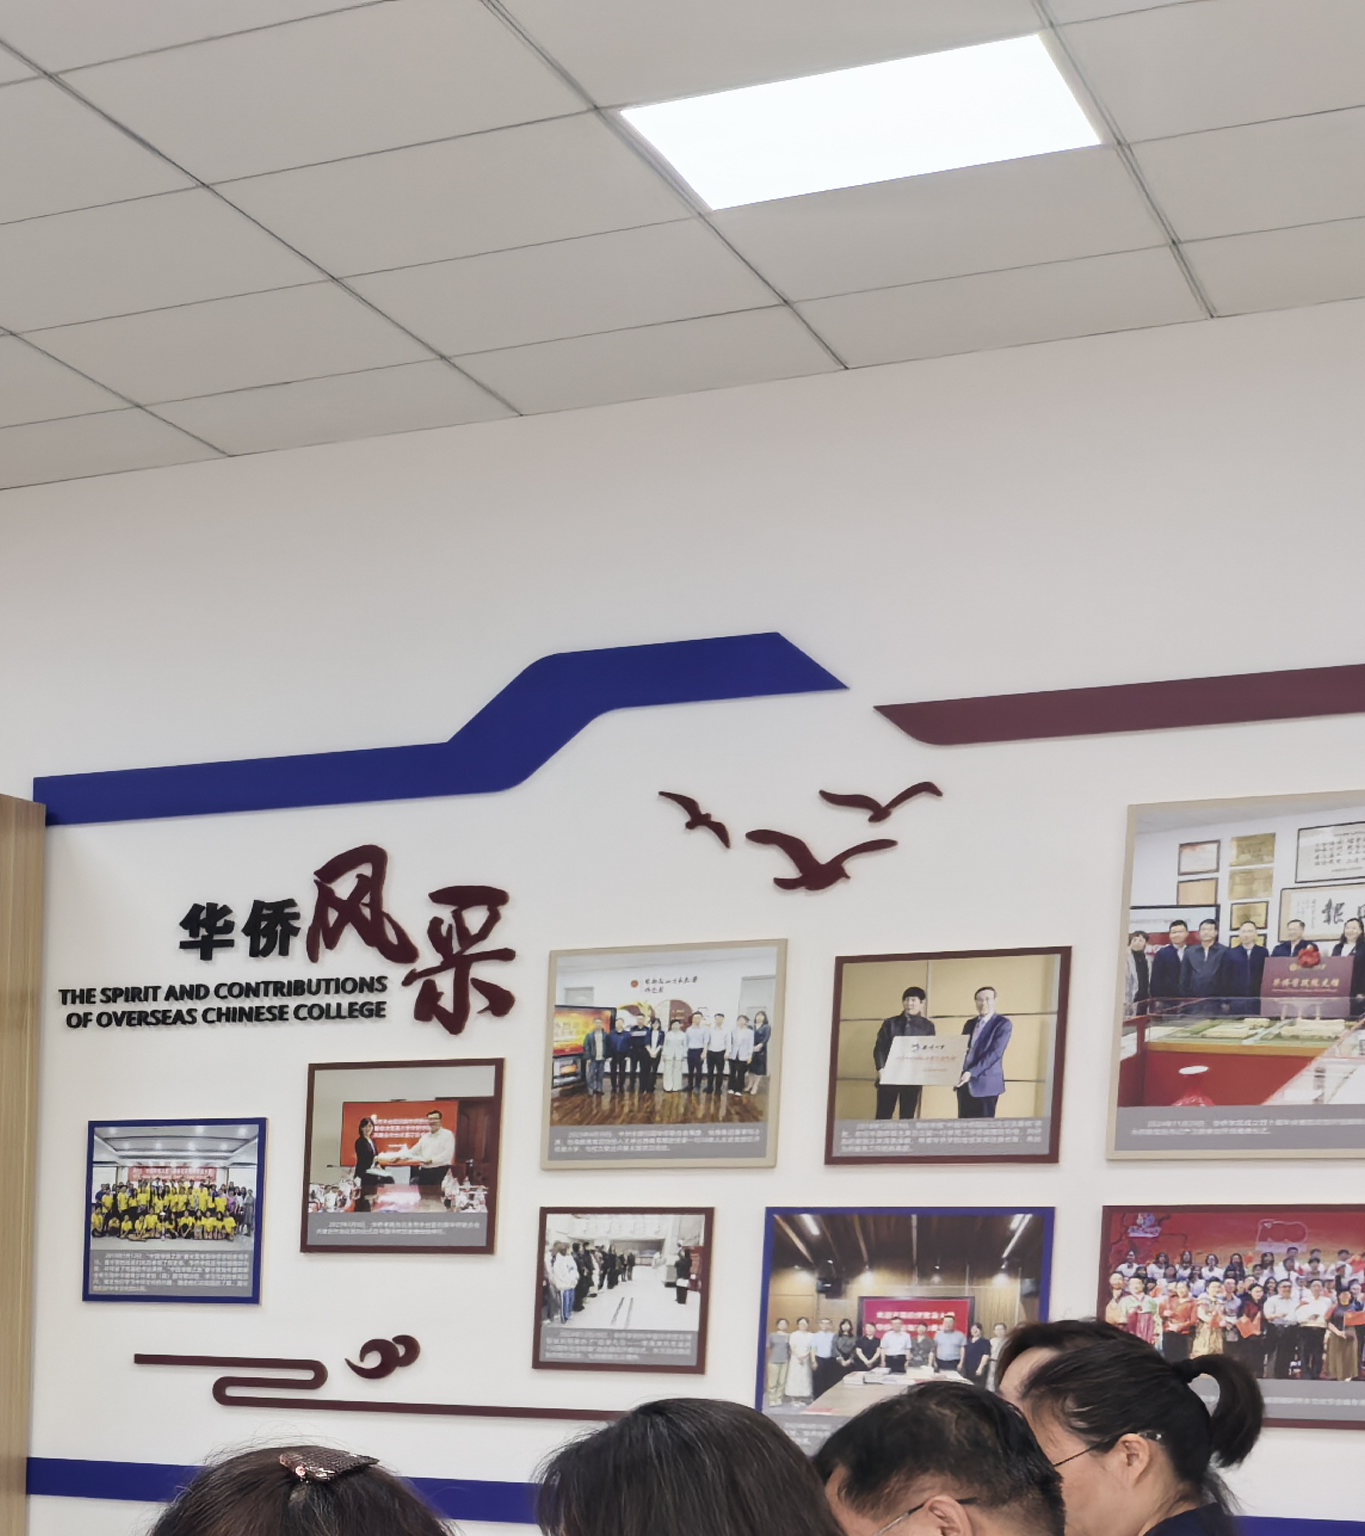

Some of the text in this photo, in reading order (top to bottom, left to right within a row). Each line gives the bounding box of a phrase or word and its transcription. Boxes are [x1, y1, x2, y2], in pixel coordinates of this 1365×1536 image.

[58, 976, 388, 1006] THE SPIRIT AND CONTRIBUTIONS
[65, 1000, 388, 1029] OF OVERSEAS CHINESE COLLEGE
